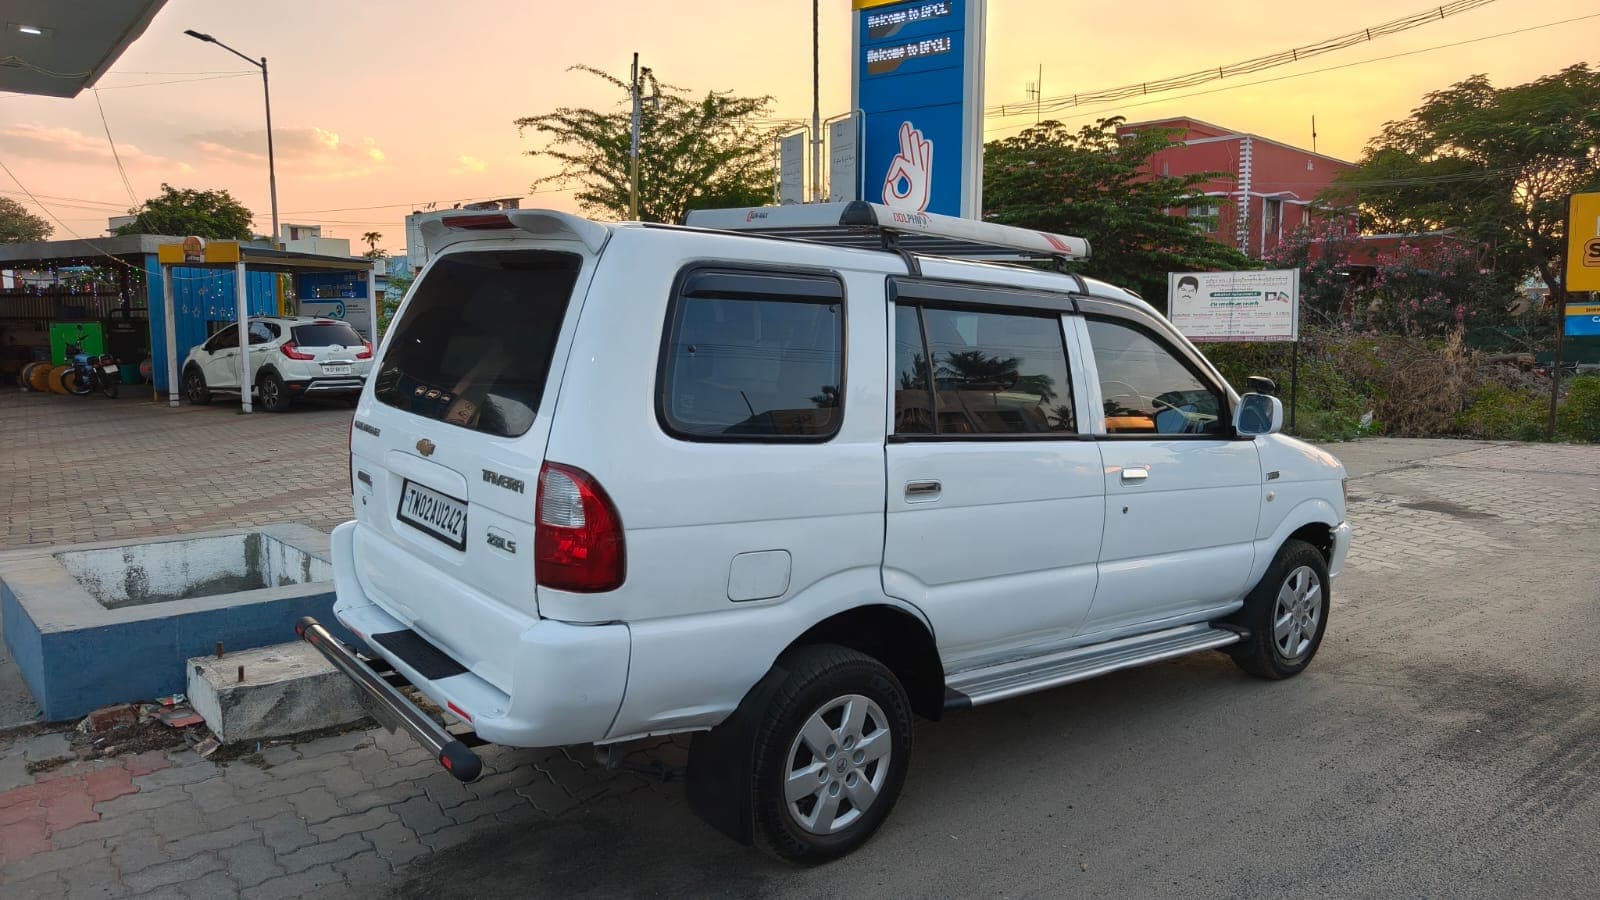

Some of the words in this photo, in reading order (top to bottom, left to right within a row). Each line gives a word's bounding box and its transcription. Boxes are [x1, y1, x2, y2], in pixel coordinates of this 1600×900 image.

[868, 12, 905, 28] Welcome
[909, 9, 919, 20] to
[867, 46, 905, 63] Welcome
[907, 43, 918, 56] to
[481, 468, 525, 495] TAVERA
